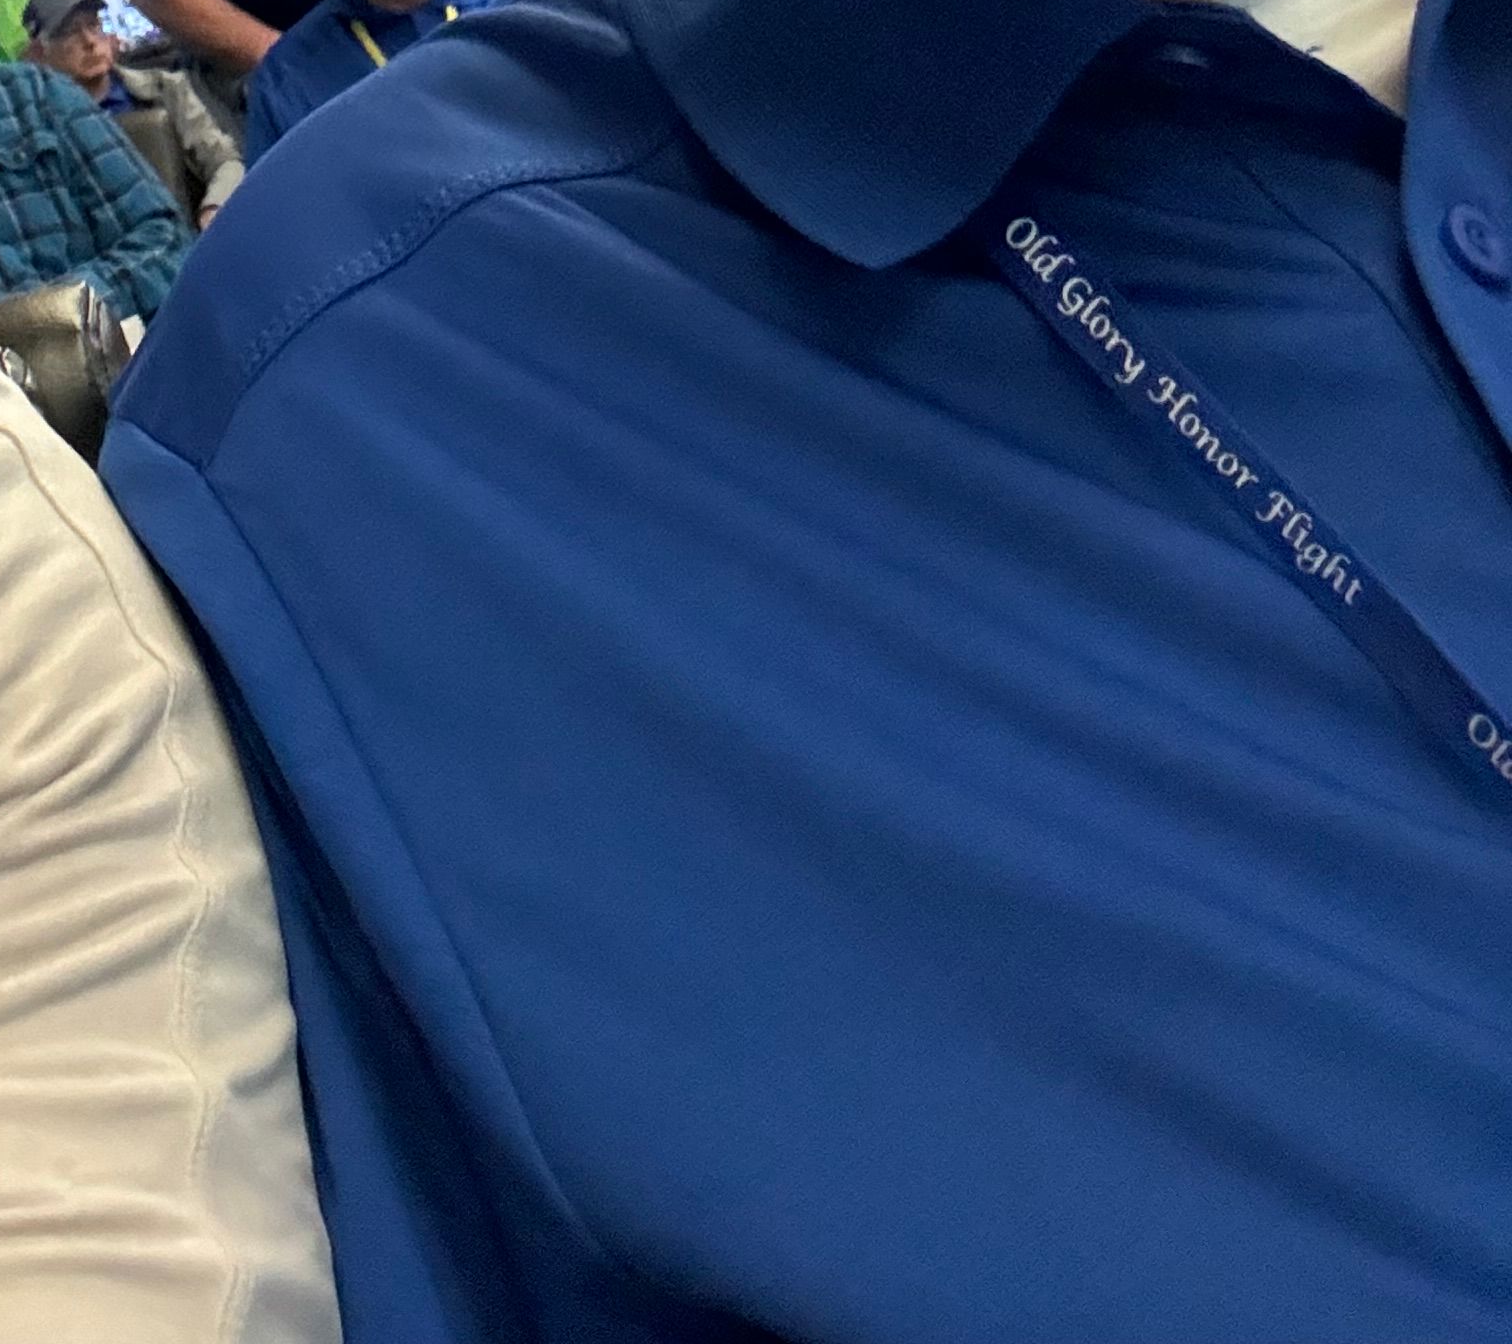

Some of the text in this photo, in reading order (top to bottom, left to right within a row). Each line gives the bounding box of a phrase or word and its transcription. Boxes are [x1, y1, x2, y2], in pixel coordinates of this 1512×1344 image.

[1005, 217, 1363, 606] Old Glory Honor Flight
